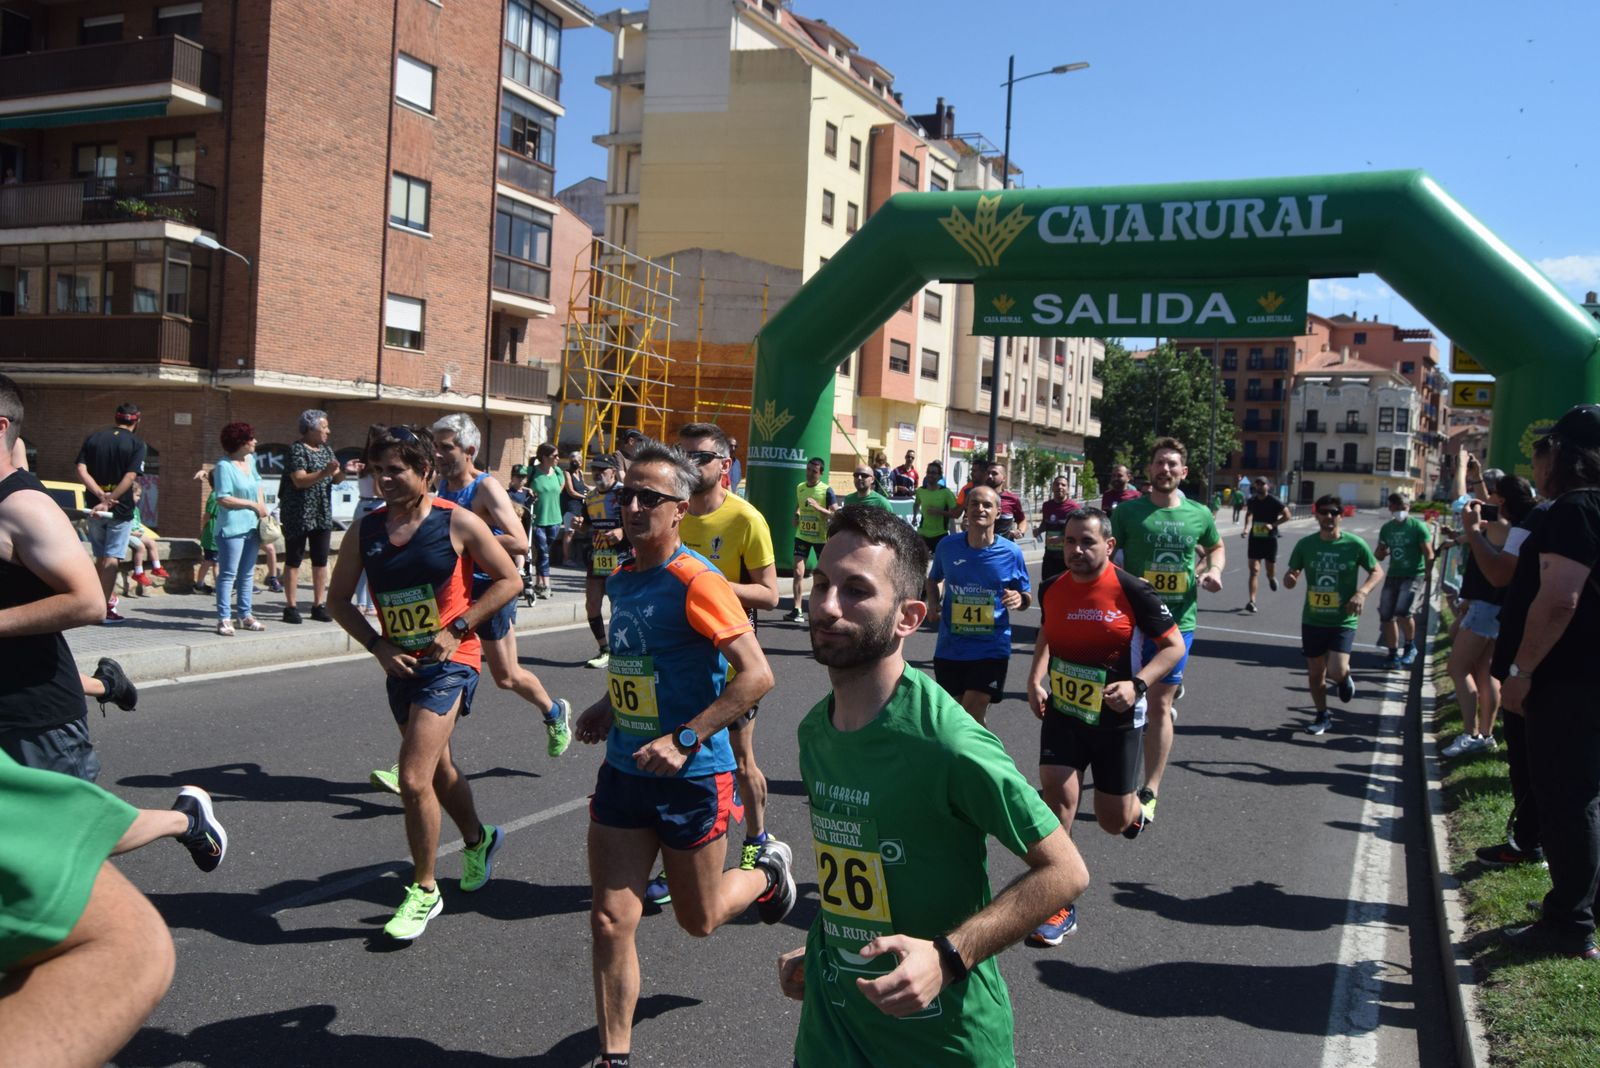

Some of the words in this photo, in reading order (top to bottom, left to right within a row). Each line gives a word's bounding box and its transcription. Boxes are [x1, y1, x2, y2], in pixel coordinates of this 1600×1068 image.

[1038, 203, 1154, 246] CAJA
[1159, 194, 1343, 241] RURAL
[1031, 292, 1237, 325] SALIDA
[761, 447, 808, 462] RURAL
[801, 521, 816, 530] 204
[597, 557, 613, 567] 181
[1155, 574, 1177, 590] 88
[1315, 593, 1330, 606] 79
[388, 604, 433, 633] 202
[963, 606, 982, 622] 41
[1066, 613, 1104, 622] zamora
[612, 678, 639, 711] 96
[1056, 677, 1094, 706] 192
[829, 784, 870, 806] CARRERA
[829, 831, 863, 848] RURAL
[820, 852, 874, 911] 26
